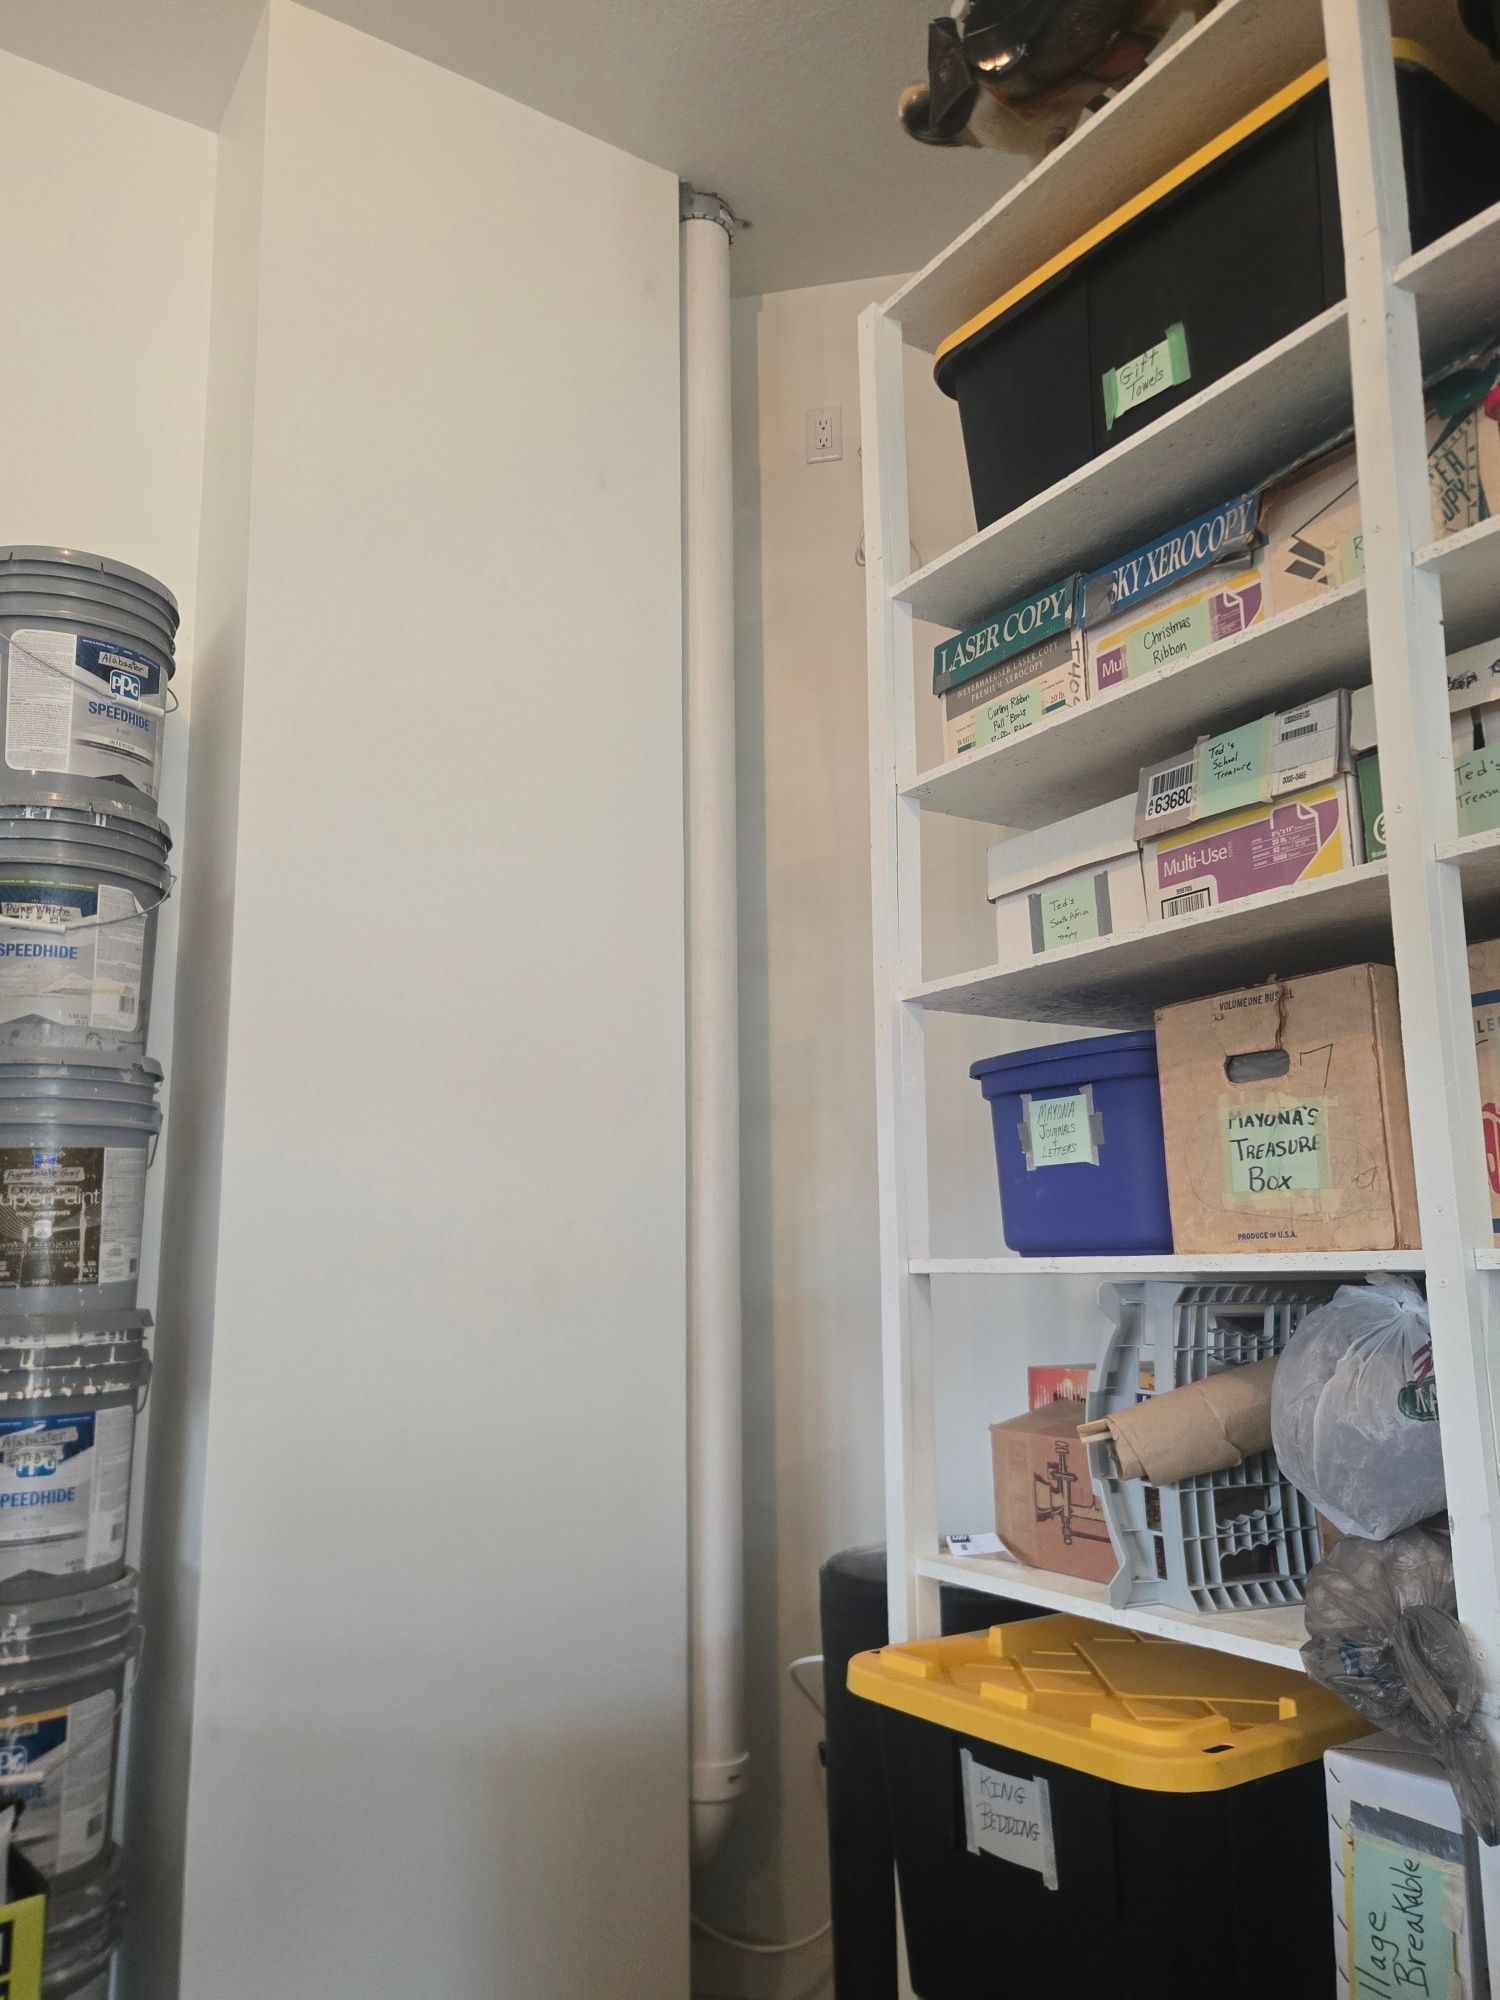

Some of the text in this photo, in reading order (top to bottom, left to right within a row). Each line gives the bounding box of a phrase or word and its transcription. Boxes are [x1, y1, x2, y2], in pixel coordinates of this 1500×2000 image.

[1120, 349, 1160, 384] Gift
[1126, 368, 1164, 400] Towels
[1145, 499, 1254, 588] XEROCOPY
[940, 588, 1066, 674] LASER COPY
[1143, 616, 1191, 650] Christmas
[101, 653, 145, 673] Alabaster
[1013, 653, 1036, 670] LASER
[1038, 640, 1058, 657] COPY
[1152, 642, 1187, 665] Ribbon
[1005, 660, 1043, 686] XEROCOPY
[111, 674, 139, 697] PPG
[1010, 693, 1031, 709] Ribbon
[88, 701, 151, 732] SPEEDHIDE
[992, 719, 1005, 733] Pull
[1207, 741, 1235, 760] Ted's
[1214, 761, 1253, 781] Treasure
[1456, 787, 1500, 809] Treasu
[1163, 847, 1228, 878] Multi-Use
[1049, 897, 1075, 912] Ted's
[0, 942, 78, 960] SPEEDHIDE
[1041, 1142, 1078, 1159] LETTERS
[1229, 1133, 1321, 1162] TREASURE
[1237, 1232, 1269, 1241] PRODUCE
[1277, 1231, 1298, 1239] U.S.A.
[0, 1486, 76, 1508] PEEDHIDE
[979, 1770, 1027, 1804] KING
[975, 1802, 1041, 1841] BEDDING
